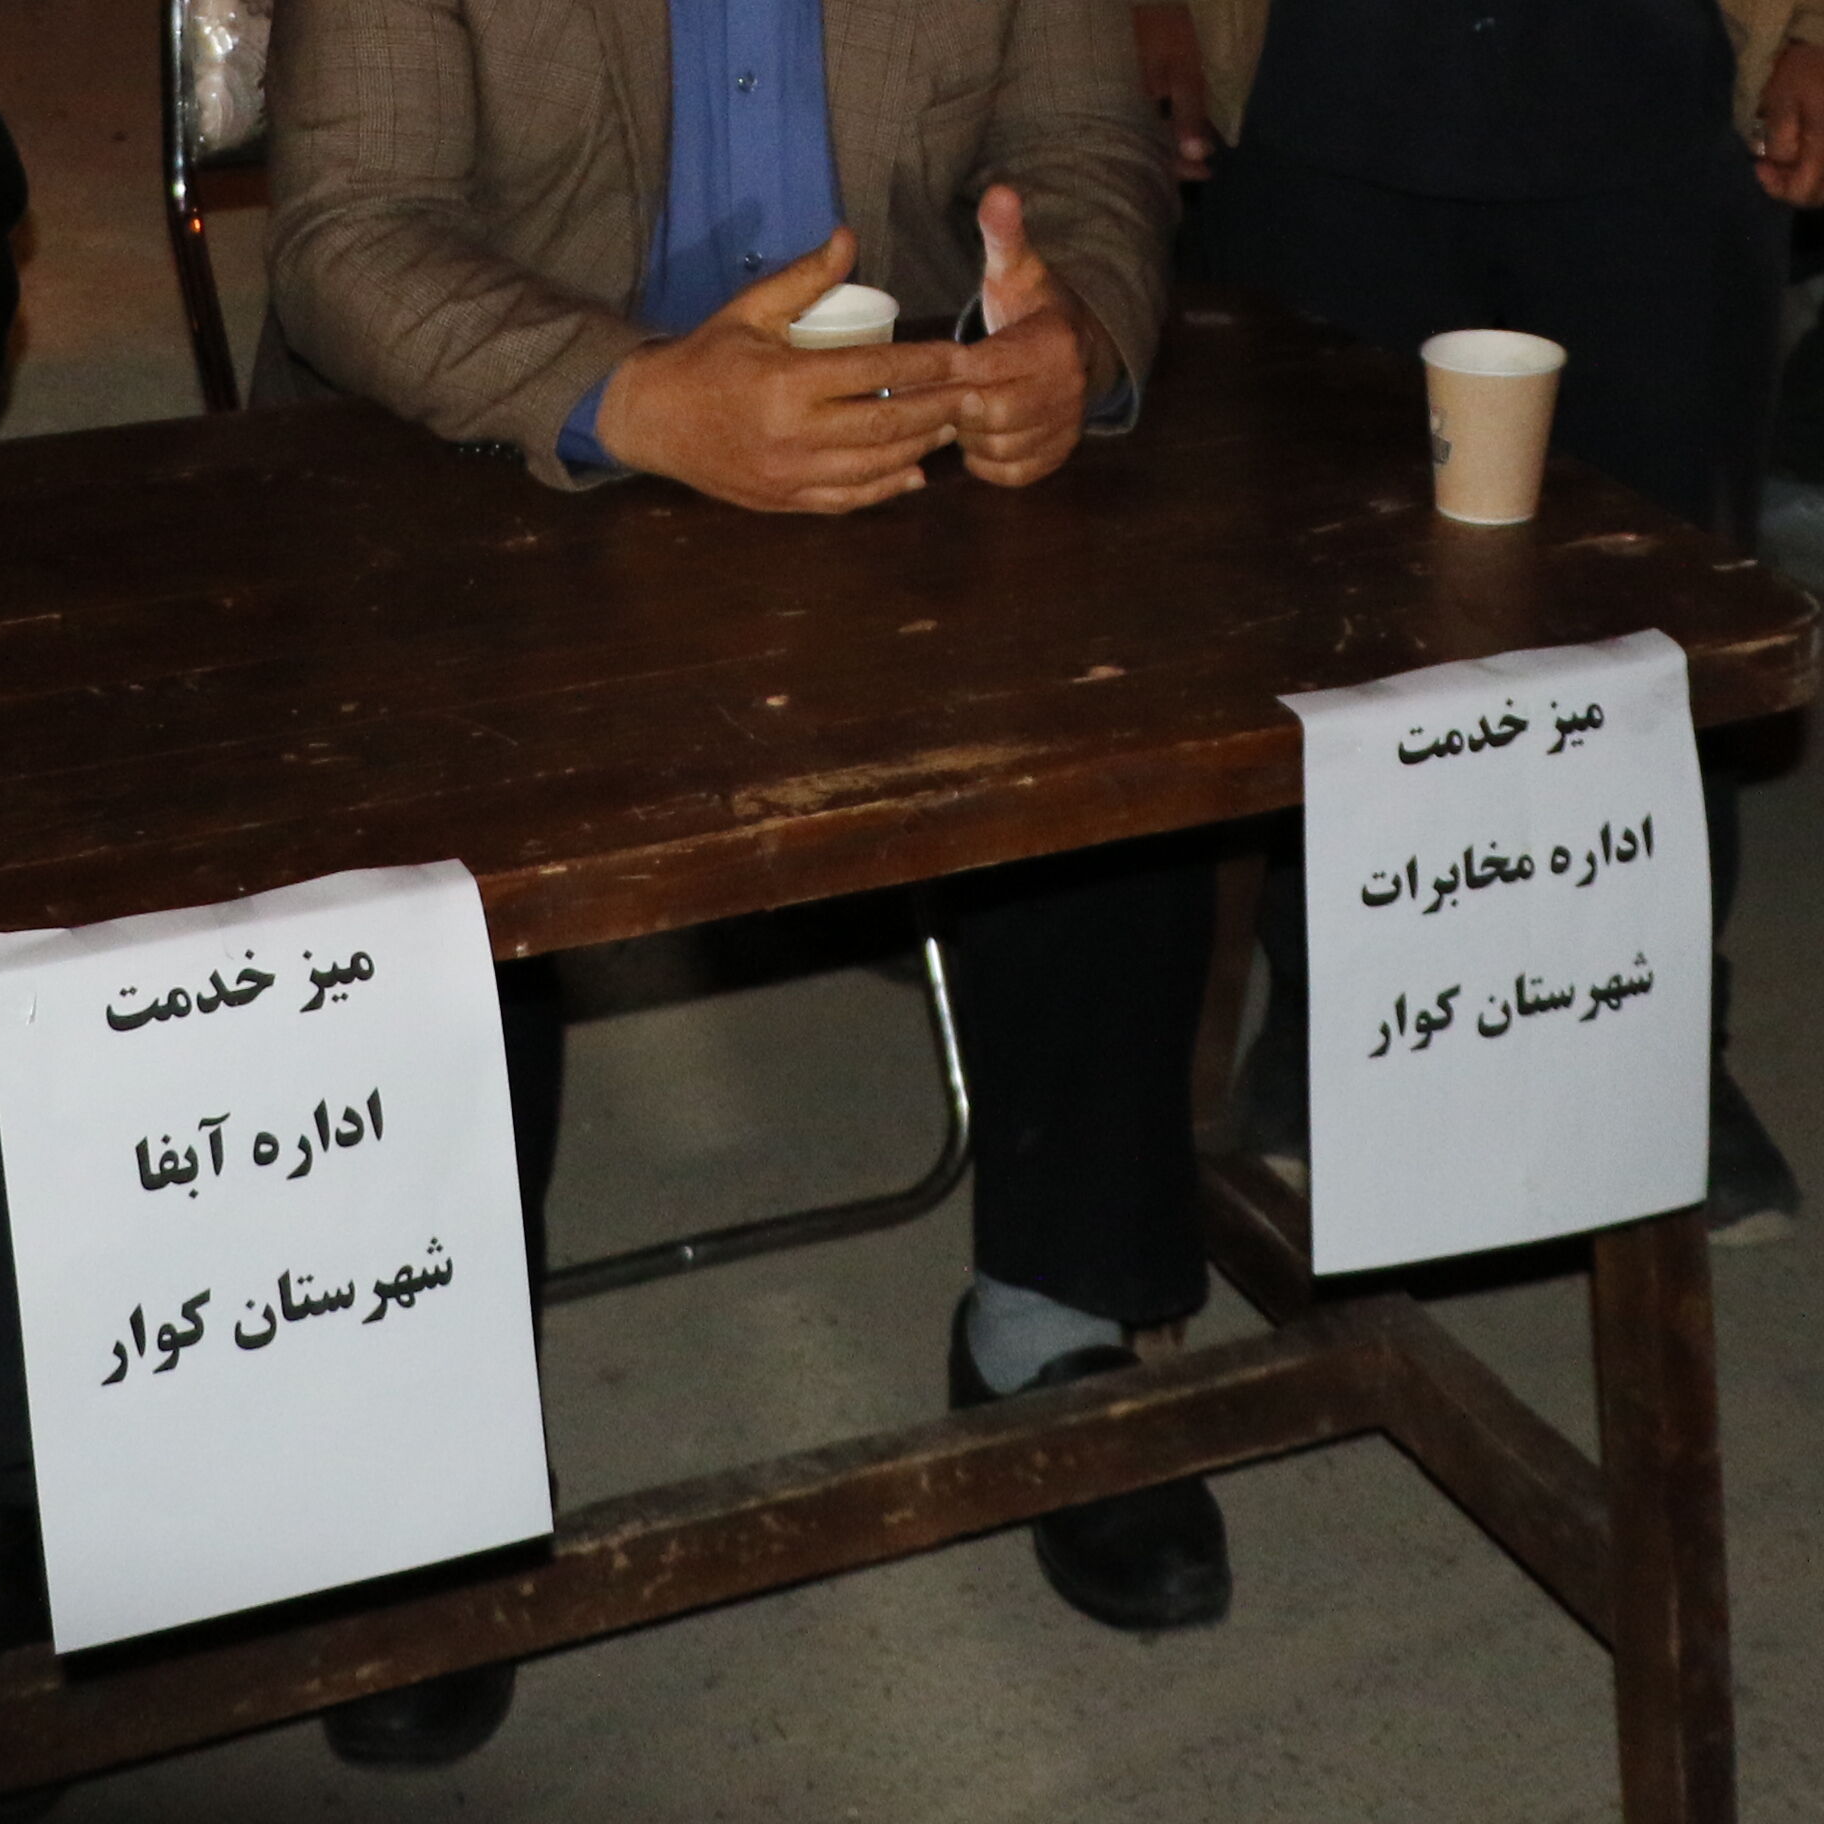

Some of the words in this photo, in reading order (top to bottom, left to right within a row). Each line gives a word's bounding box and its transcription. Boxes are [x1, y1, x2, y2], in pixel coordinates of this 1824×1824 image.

[1398, 699, 1528, 766] خدمت
[1547, 702, 1604, 755] میز
[1361, 842, 1535, 914] مخابرات
[1550, 814, 1653, 886] اداره
[106, 950, 275, 1032] خدمت
[300, 951, 374, 1013] میز
[1477, 951, 1653, 1039] شهرستان
[1369, 985, 1460, 1058] کوار
[135, 1113, 229, 1198] آبفا
[253, 1087, 383, 1180] اداره
[234, 1238, 453, 1351] شهرستان
[101, 1289, 210, 1386] کوار
